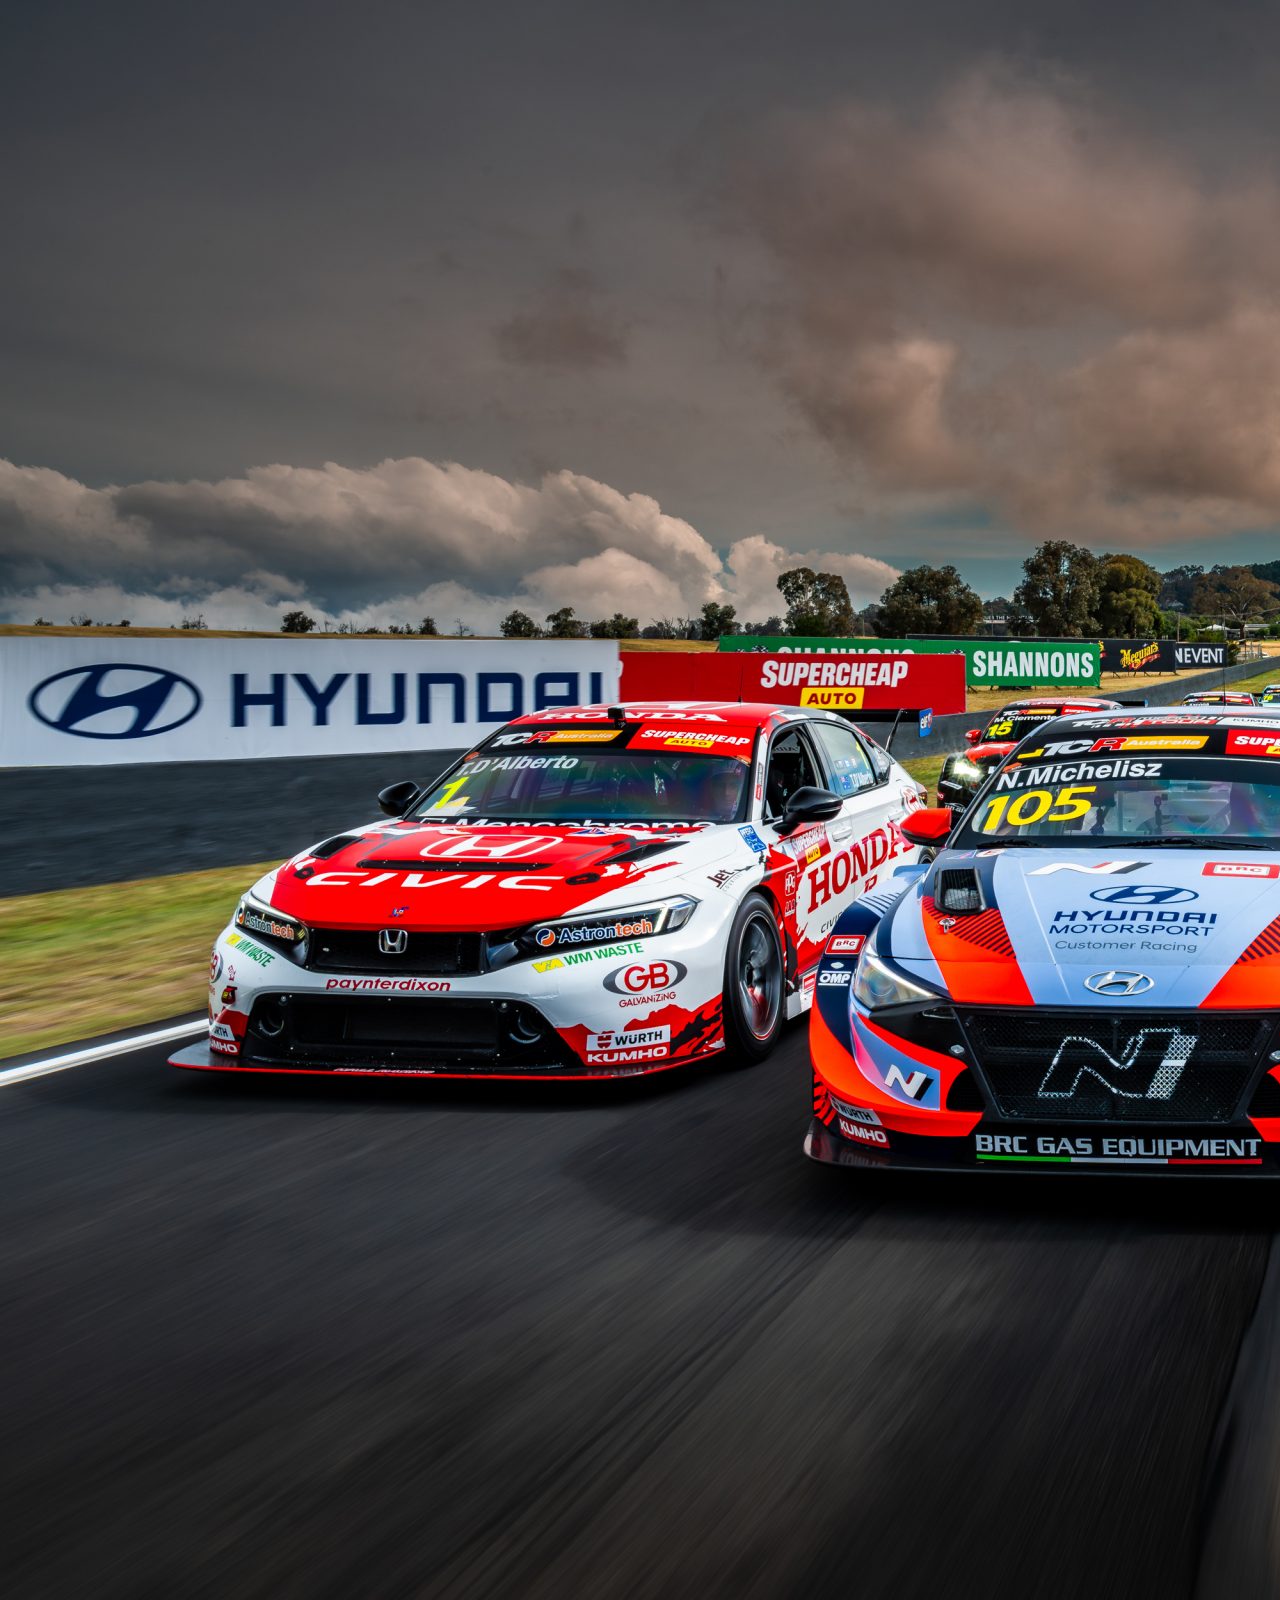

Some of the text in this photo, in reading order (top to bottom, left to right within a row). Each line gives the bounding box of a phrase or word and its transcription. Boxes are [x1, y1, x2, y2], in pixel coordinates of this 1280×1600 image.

[761, 659, 908, 689] SUPERCHEAP
[973, 650, 1095, 679] SHANNONS
[230, 671, 604, 728] HYUNDAI
[807, 691, 858, 706] AUTO
[640, 729, 751, 746] SUPERCHEAP
[987, 719, 1013, 737] 15
[669, 739, 709, 747] AUTO
[1129, 738, 1200, 747] Australia
[435, 777, 467, 809] 1
[982, 785, 1097, 830] 105
[808, 821, 915, 915] HONDA
[305, 871, 566, 891] CIVIC
[706, 869, 735, 888] Jet
[1053, 910, 1219, 924] HYUNDAI
[558, 918, 654, 944] Astrontech
[1048, 924, 1215, 937] MOTORSPORT
[245, 946, 276, 968] WASTE
[562, 942, 645, 966] WM WASTE
[1054, 940, 1198, 955] Customer Racing
[325, 977, 452, 992] paynterdixon
[623, 962, 671, 992] GB
[819, 973, 851, 984] OMP
[613, 1030, 664, 1046] WÜRTH
[587, 1046, 669, 1063] KUMHO
[840, 1119, 887, 1142] KUMHO
[975, 1133, 1261, 1158] BRC GAS EQUIPMENT
